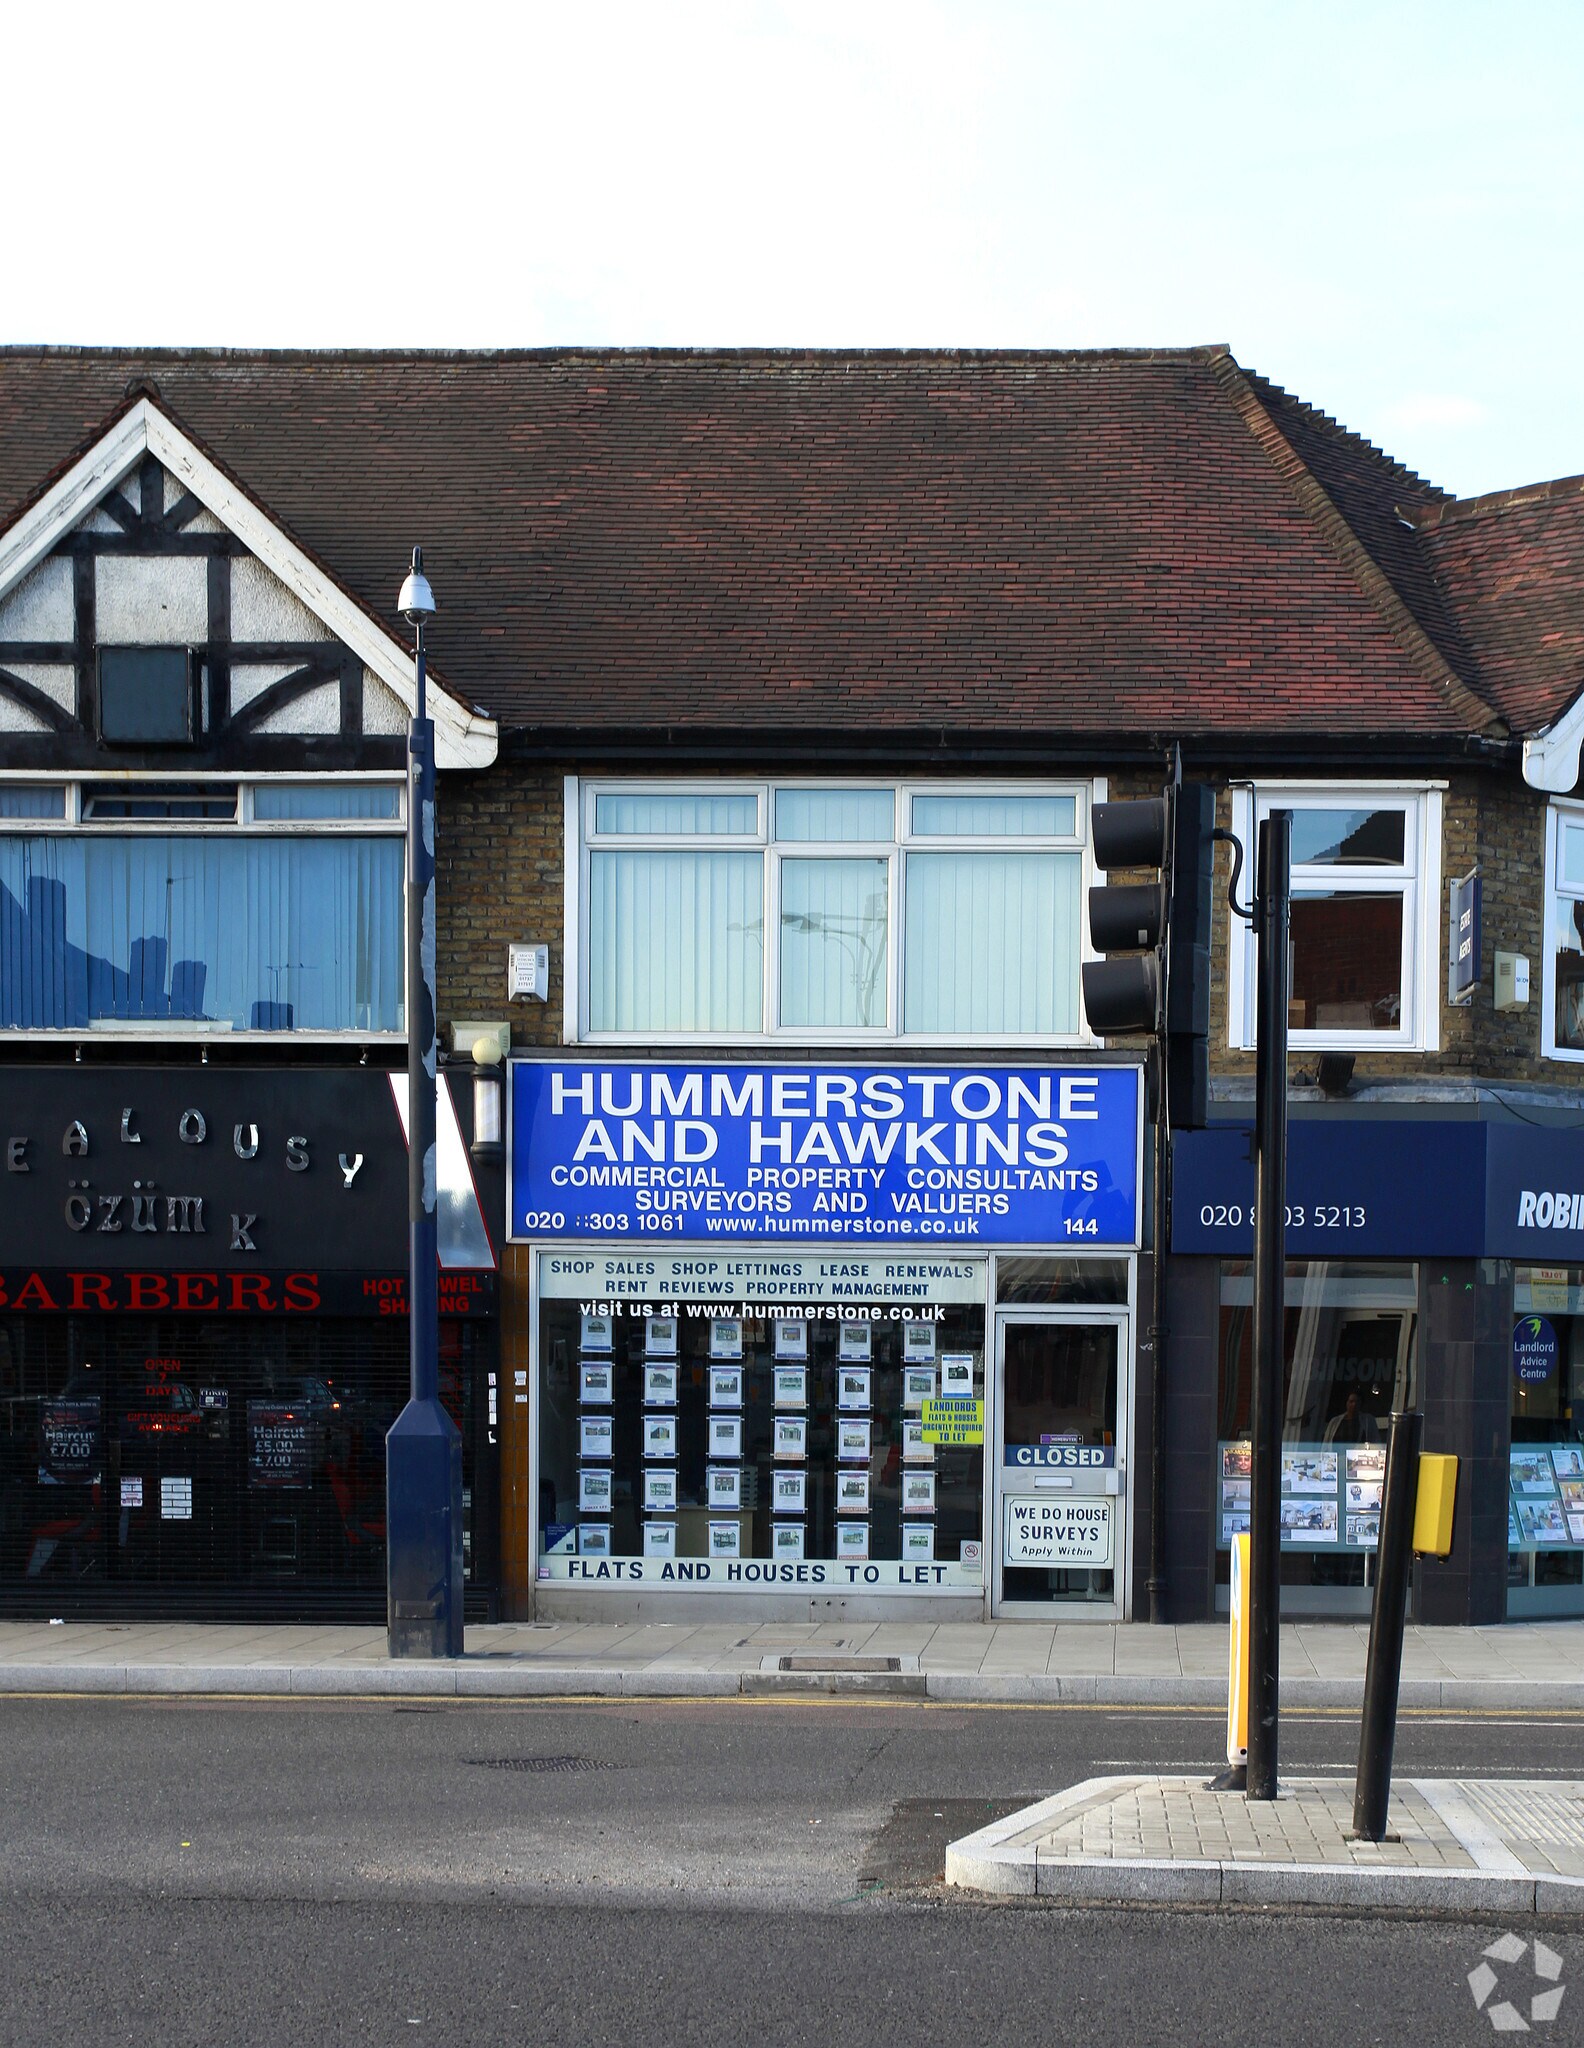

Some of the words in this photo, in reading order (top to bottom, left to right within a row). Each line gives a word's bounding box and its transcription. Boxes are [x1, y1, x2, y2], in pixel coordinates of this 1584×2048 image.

[551, 1072, 1099, 1120] HUMMERSTONE
[572, 1119, 719, 1163] AND
[750, 1121, 1070, 1167] HAWKINS
[550, 1165, 725, 1188] COMMERCIAL
[747, 1167, 886, 1189] PROPERTY
[907, 1169, 1099, 1191] CONSULTANTS
[635, 1189, 792, 1212] SURVEYORS
[812, 1192, 868, 1214] AND
[890, 1193, 1010, 1215] VALUERS
[525, 1211, 566, 1230] 020
[637, 1214, 684, 1231] 1061
[705, 1215, 980, 1234] www.hummerstone.co.uk
[1063, 1217, 1099, 1235] 144
[1200, 1205, 1243, 1227] 020
[1313, 1206, 1366, 1228] 5213
[550, 1260, 595, 1274] SHOP
[605, 1261, 655, 1275] SALES
[671, 1262, 718, 1276] SHOP
[727, 1263, 803, 1277] LETTINGS
[820, 1264, 869, 1277] LEASE
[885, 1265, 974, 1278] RENEWALS
[0, 1271, 322, 1312] ARBERS
[363, 1278, 405, 1296] HOT
[605, 1280, 648, 1294] RENT
[659, 1281, 734, 1295] REVIEWS
[746, 1282, 824, 1296] PROPERTY
[831, 1283, 929, 1297] MANAGEMENT
[580, 1299, 623, 1317] visit
[629, 1303, 653, 1318] us
[660, 1301, 680, 1318] at
[686, 1301, 946, 1321] www.hummerstone.co.uk
[1514, 1342, 1555, 1353] Landlord
[144, 1358, 181, 1372] OPEN
[1520, 1356, 1548, 1367] Advice
[1520, 1368, 1547, 1379] Centre
[930, 1401, 977, 1412] LANDLORDS
[45, 1429, 95, 1443] Haircut
[253, 1425, 306, 1440] Haircut
[939, 1432, 950, 1442] TO
[952, 1432, 967, 1442] LET
[1016, 1448, 1105, 1466] CLOSED
[1014, 1507, 1036, 1520] WE
[1041, 1508, 1062, 1520] DO
[1066, 1508, 1108, 1521] HOUSE
[1020, 1525, 1099, 1541] SURVEYS
[1021, 1545, 1053, 1557] Apply
[1058, 1546, 1093, 1557] Within
[568, 1560, 644, 1579] FLATS
[660, 1562, 711, 1580] AND
[727, 1563, 826, 1582] HOUSES
[845, 1565, 880, 1584] TO
[898, 1566, 948, 1584] LET
